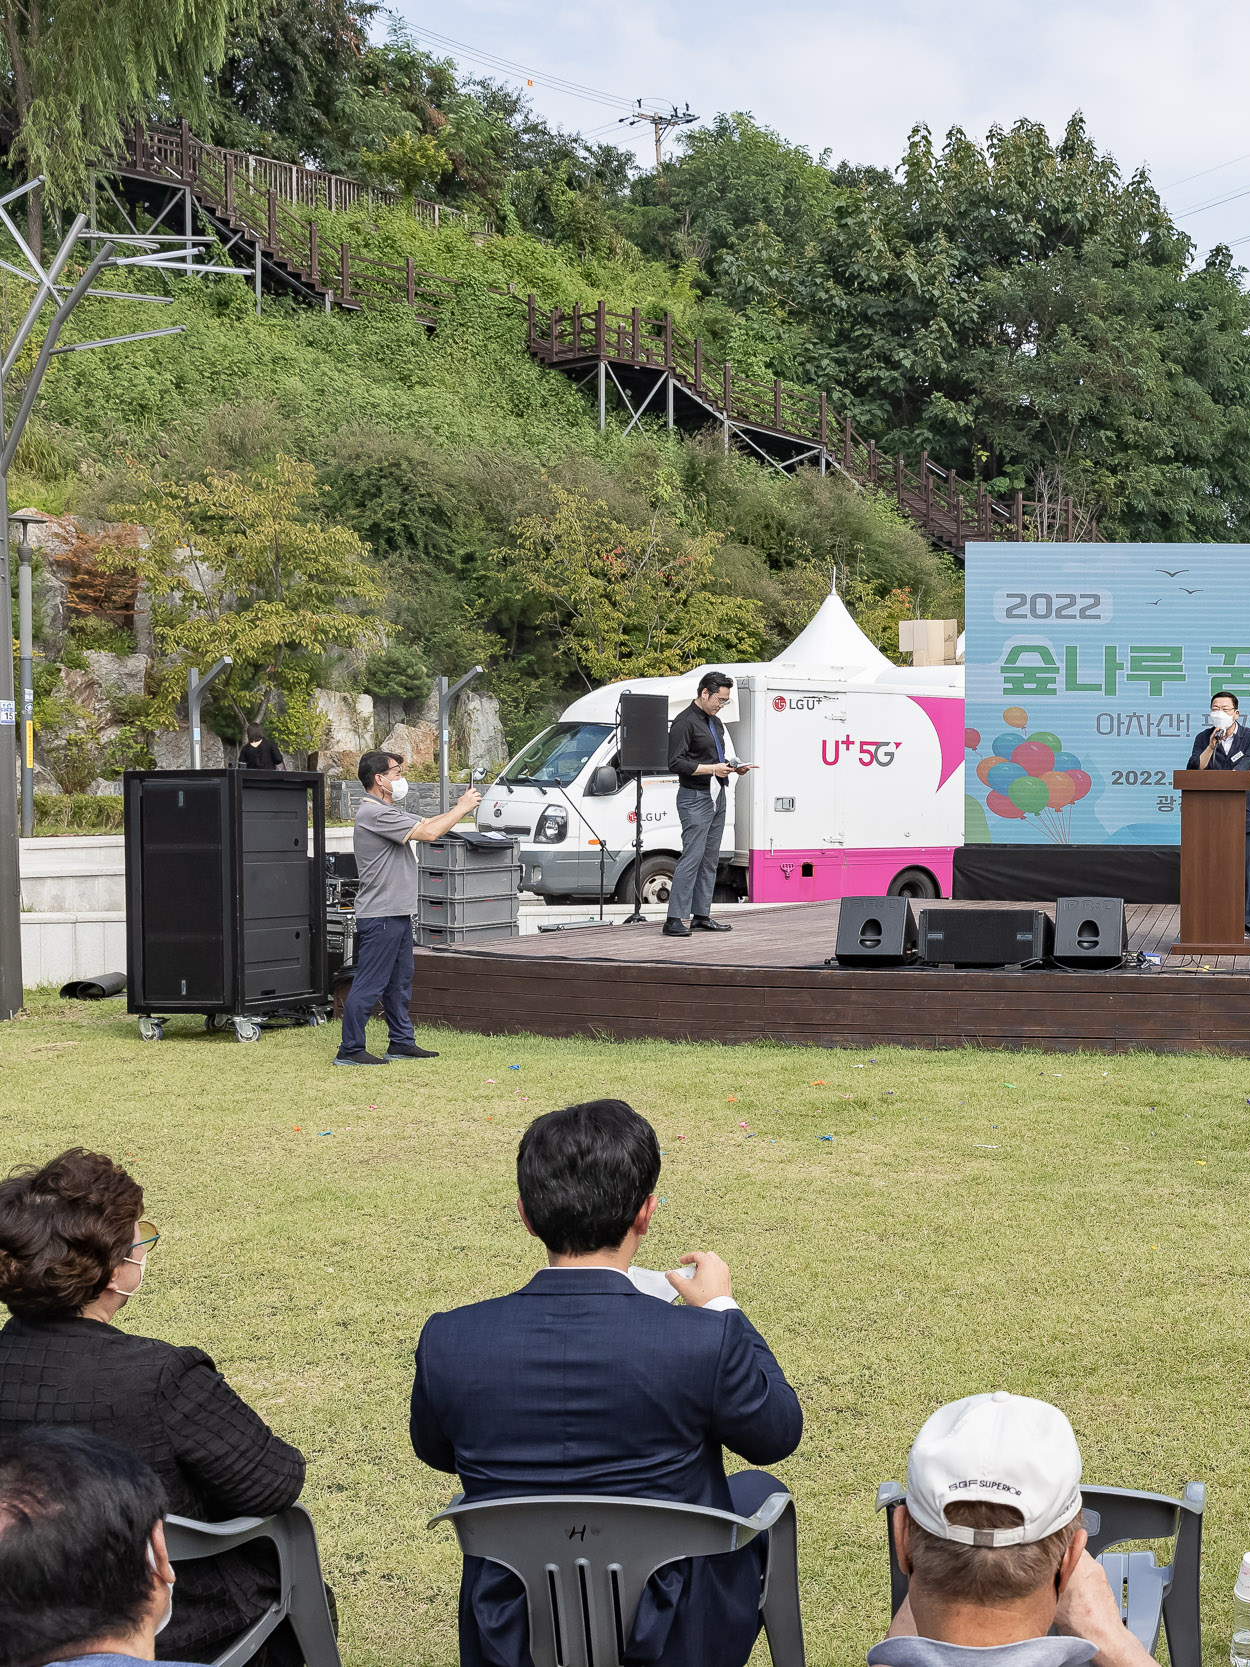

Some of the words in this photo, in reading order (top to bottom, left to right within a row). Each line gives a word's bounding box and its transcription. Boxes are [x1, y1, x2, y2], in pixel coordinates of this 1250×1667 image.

[1005, 593, 1101, 620] 2022
[1000, 645, 1187, 697] 숲나루
[789, 699, 804, 710] LG
[1096, 712, 1191, 738] 아차산!
[822, 734, 855, 766] U+
[858, 741, 895, 767] 5G
[1111, 770, 1173, 786] 2022.
[1156, 795, 1182, 813] 광
[979, 1480, 1022, 1496] SUPERIOR
[568, 1524, 587, 1542] H
